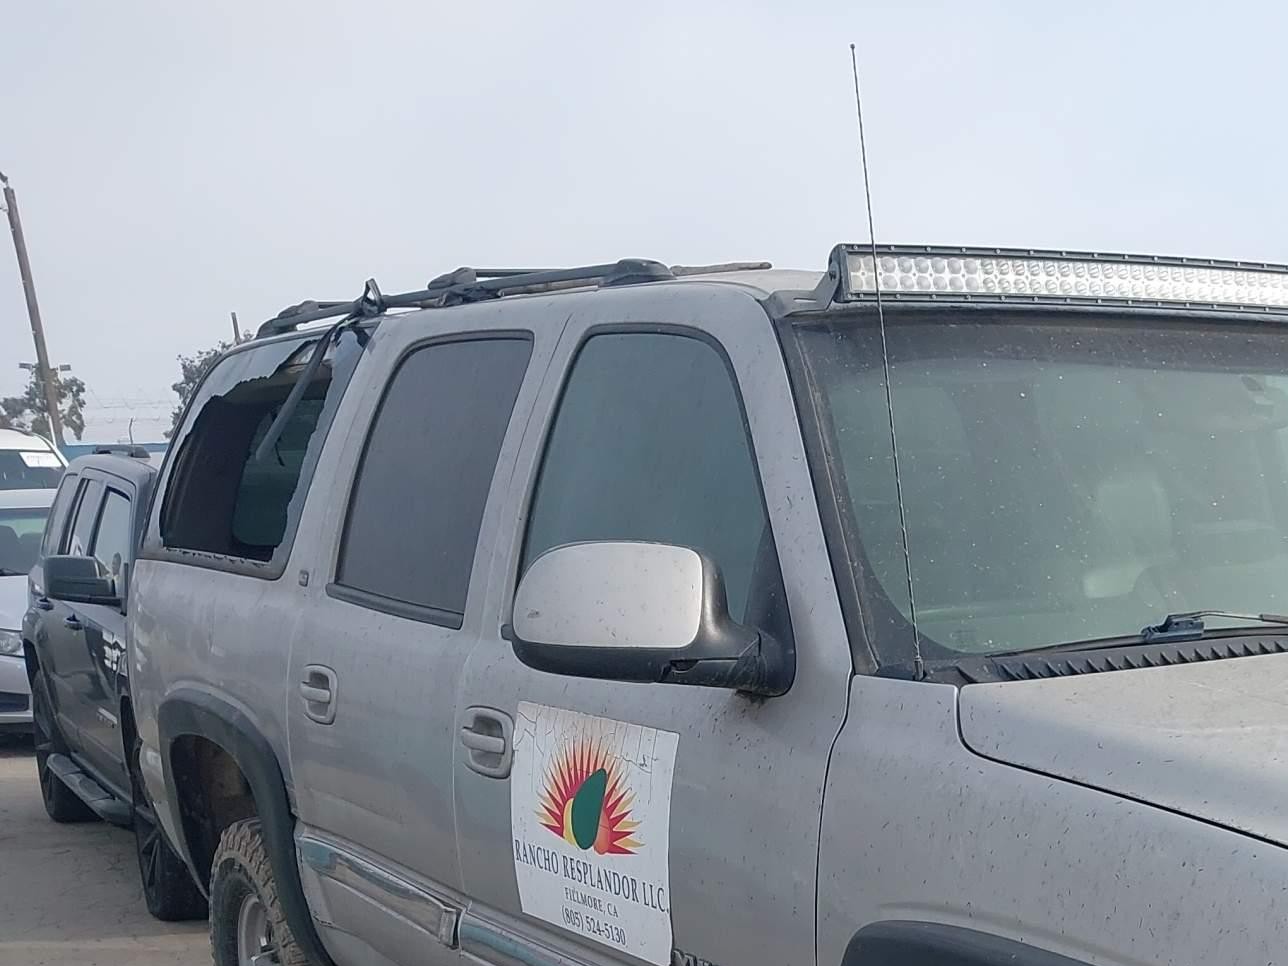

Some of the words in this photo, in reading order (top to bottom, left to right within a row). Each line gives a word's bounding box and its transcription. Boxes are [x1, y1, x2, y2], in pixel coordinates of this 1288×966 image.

[515, 839, 559, 875] RANCHO
[562, 855, 640, 904] RESPLANDOR
[564, 887, 606, 917] FILLMORE,
[607, 904, 619, 918] CA
[561, 904, 584, 932] (805)
[585, 914, 627, 946] 524-5130
